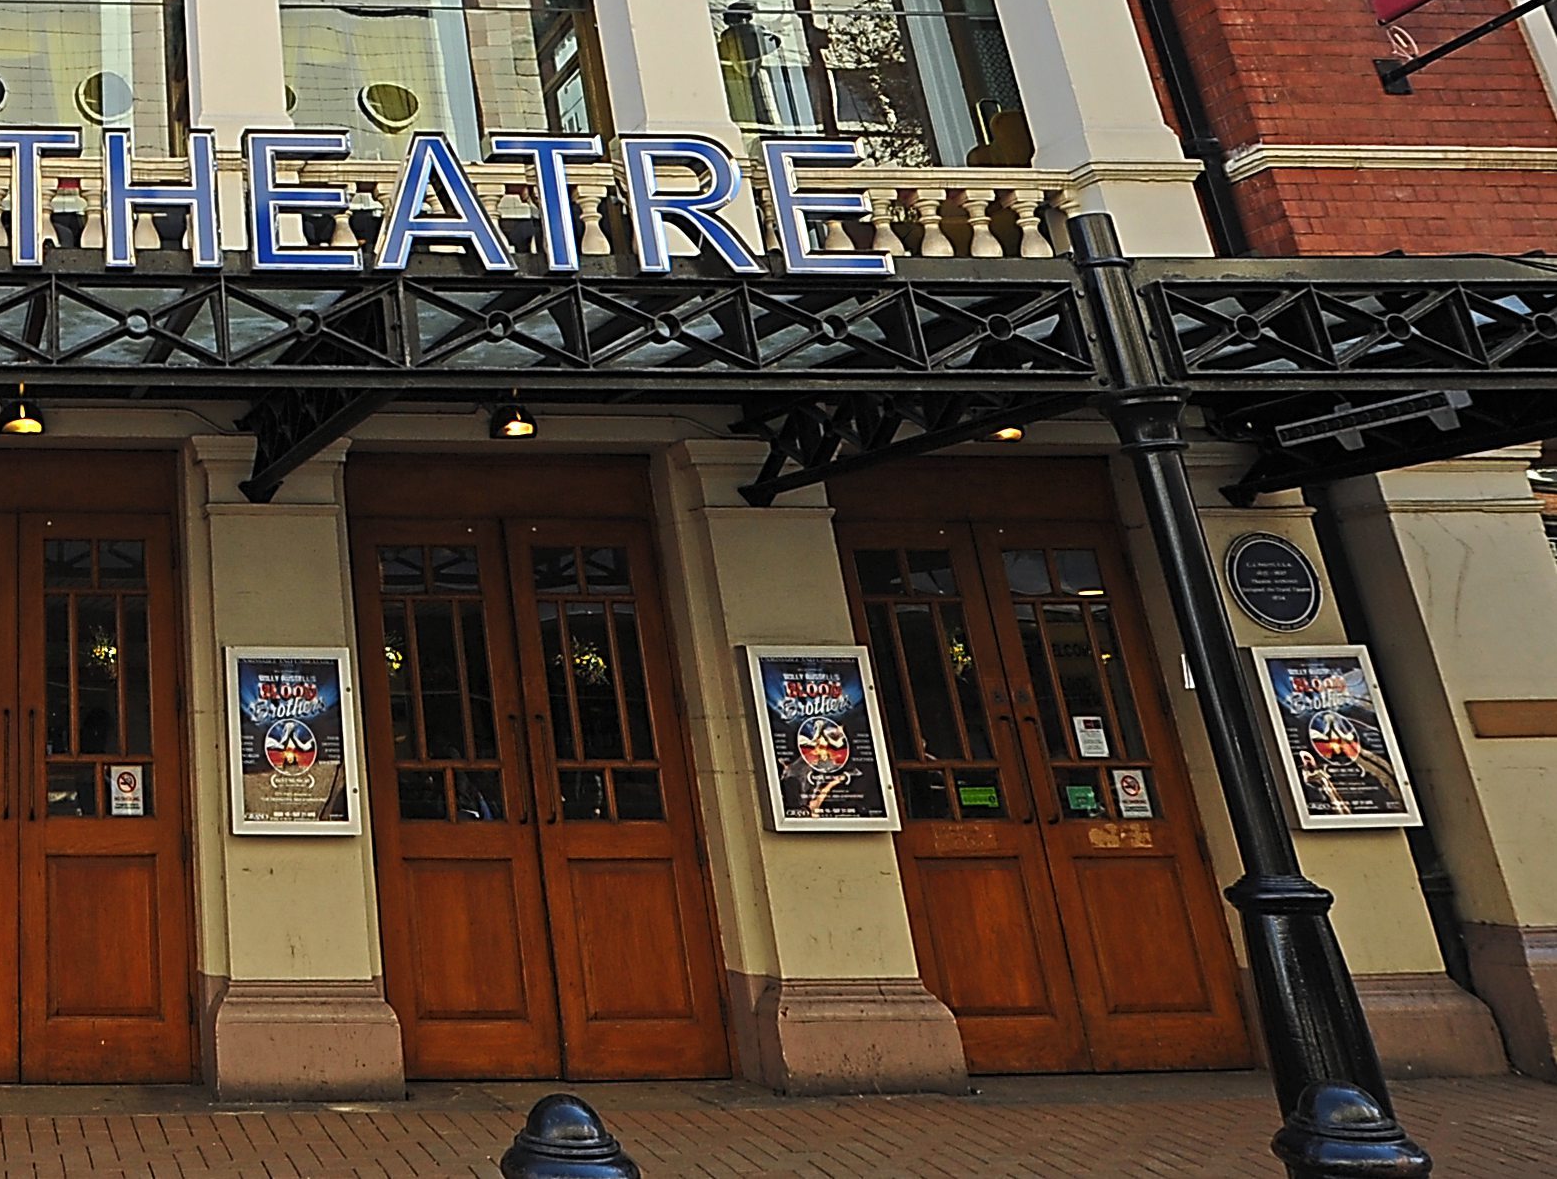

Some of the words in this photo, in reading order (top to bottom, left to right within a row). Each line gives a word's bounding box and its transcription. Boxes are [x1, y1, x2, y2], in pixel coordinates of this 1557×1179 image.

[258, 683, 318, 700] BLOOD
[783, 681, 842, 698] BLOOD
[1291, 676, 1347, 693] BLOOD
[250, 697, 326, 722] Brothers
[778, 695, 853, 720] Brothers
